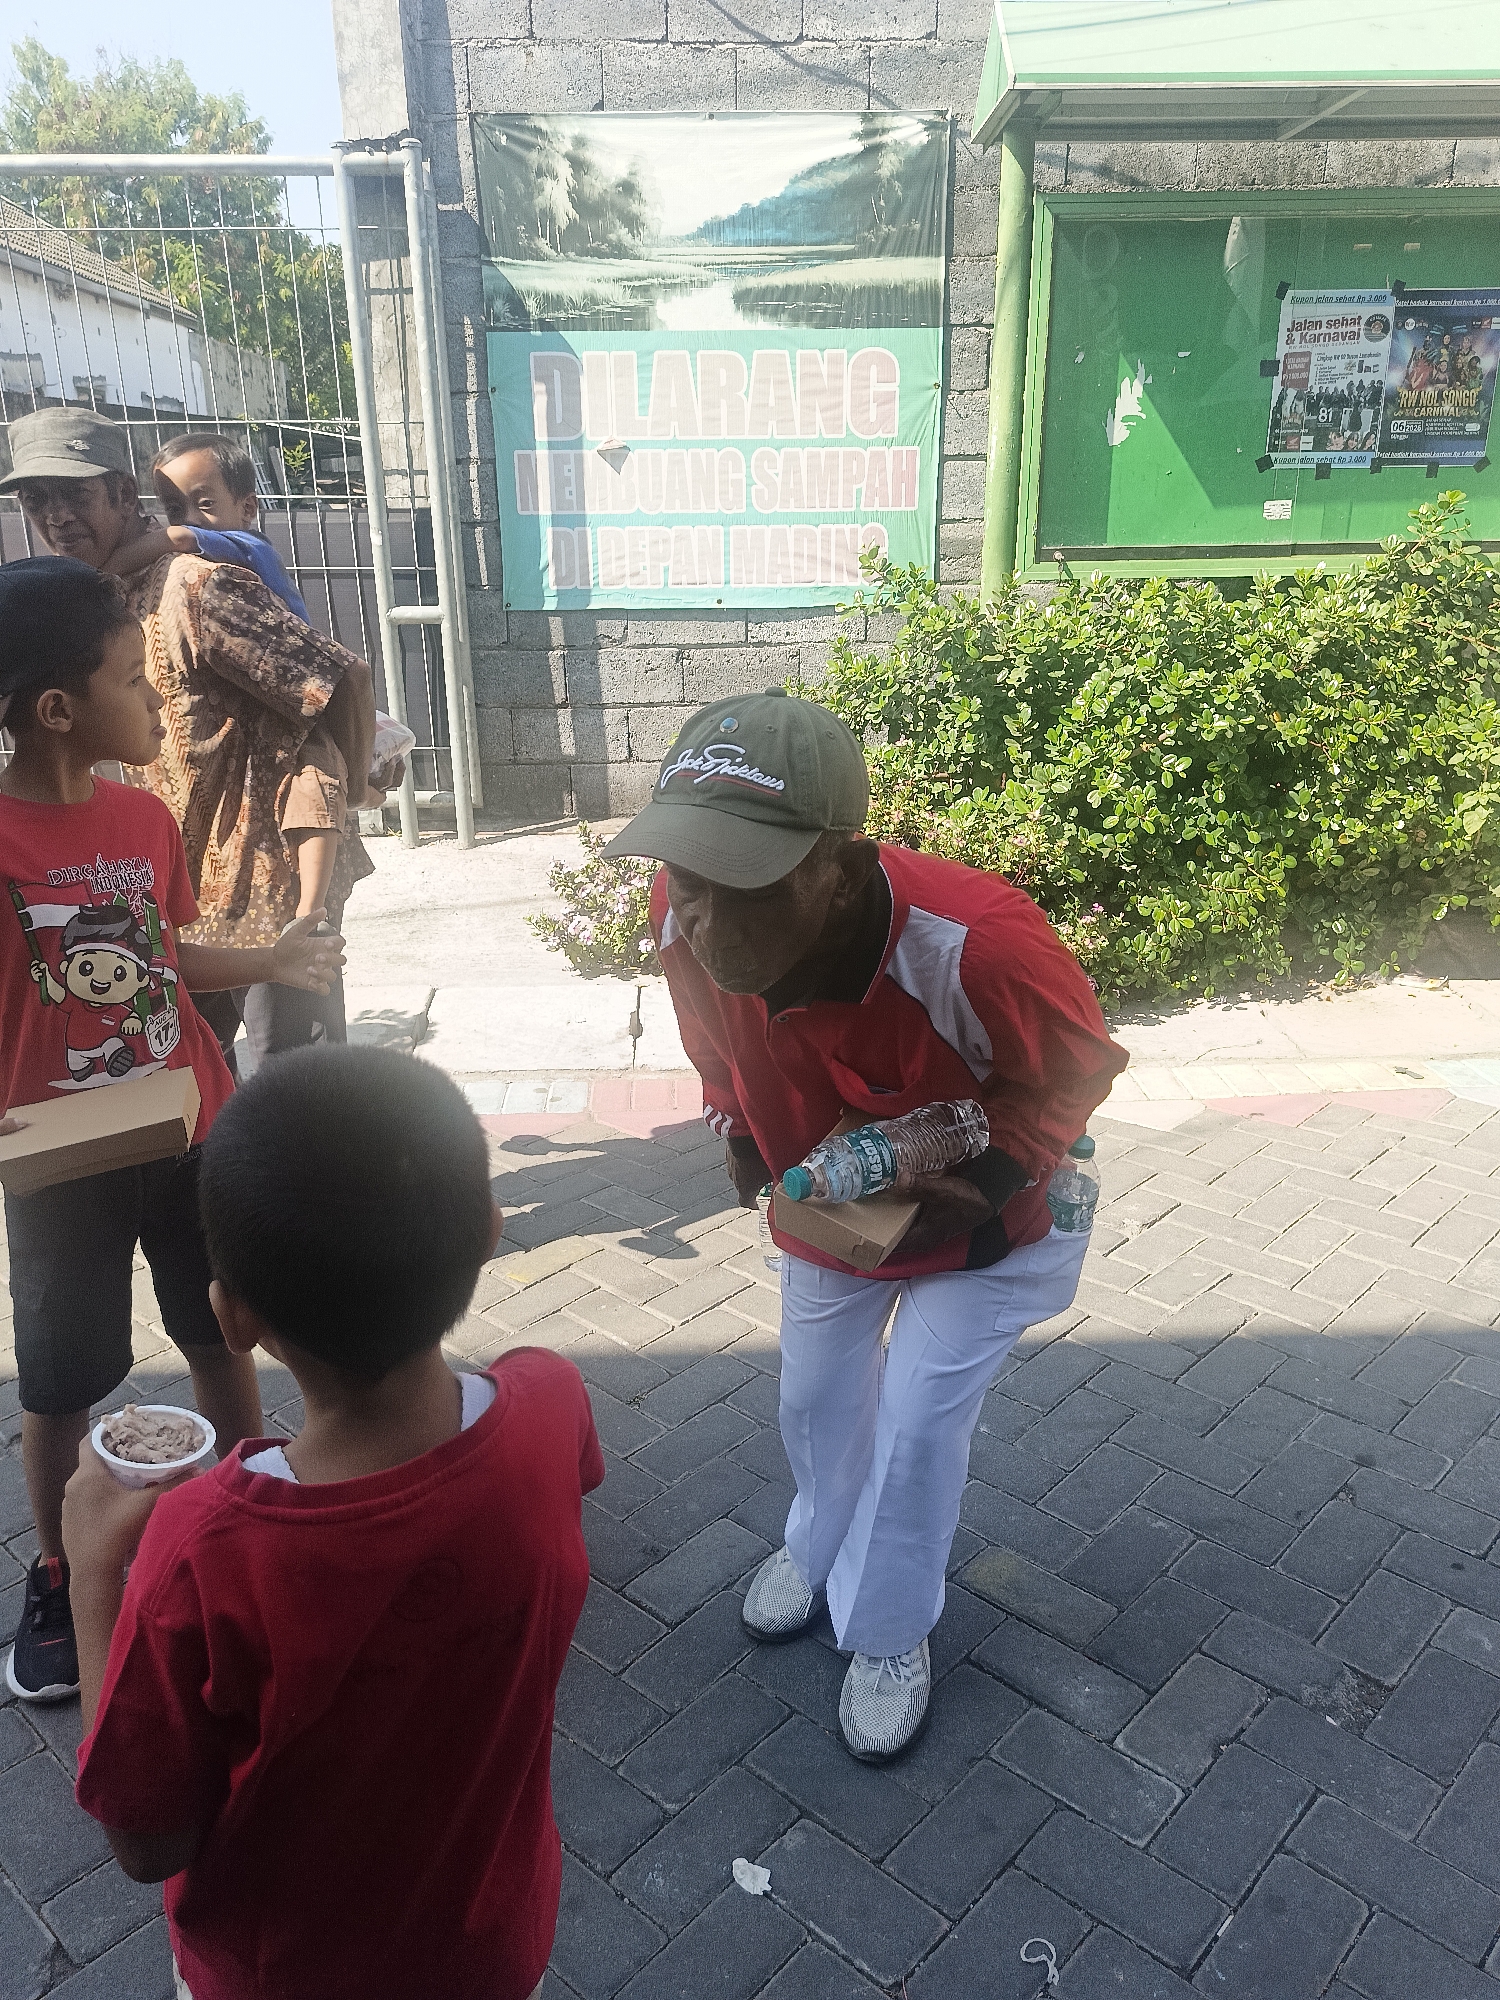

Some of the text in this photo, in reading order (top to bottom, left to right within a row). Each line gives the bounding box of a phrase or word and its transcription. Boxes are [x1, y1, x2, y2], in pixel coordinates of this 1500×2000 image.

[1290, 295, 1314, 304] Kupon
[1315, 295, 1334, 304] jalan
[1335, 295, 1356, 304] sehat
[1356, 295, 1366, 304] Rp
[1287, 318, 1322, 332] Jalan
[1325, 315, 1362, 329] sehat
[1285, 328, 1361, 345] & Karnaval
[529, 347, 901, 442] DILARANG
[1400, 389, 1477, 408] RW NOL SONGO
[1318, 407, 1333, 423] 81
[1414, 407, 1461, 417] CARNIVAL
[1392, 421, 1404, 432] 06
[1274, 456, 1367, 465] Kupon jalan sehat Rp 3.000
[514, 446, 921, 515] MEMBUANG SAMPAH
[547, 525, 593, 590] DI
[597, 523, 725, 589] DEPAN
[47, 853, 152, 886] DIRGAHAYU
[90, 870, 154, 895] INDONESIA
[154, 1014, 167, 1028] AUG
[155, 1022, 170, 1048] 17
